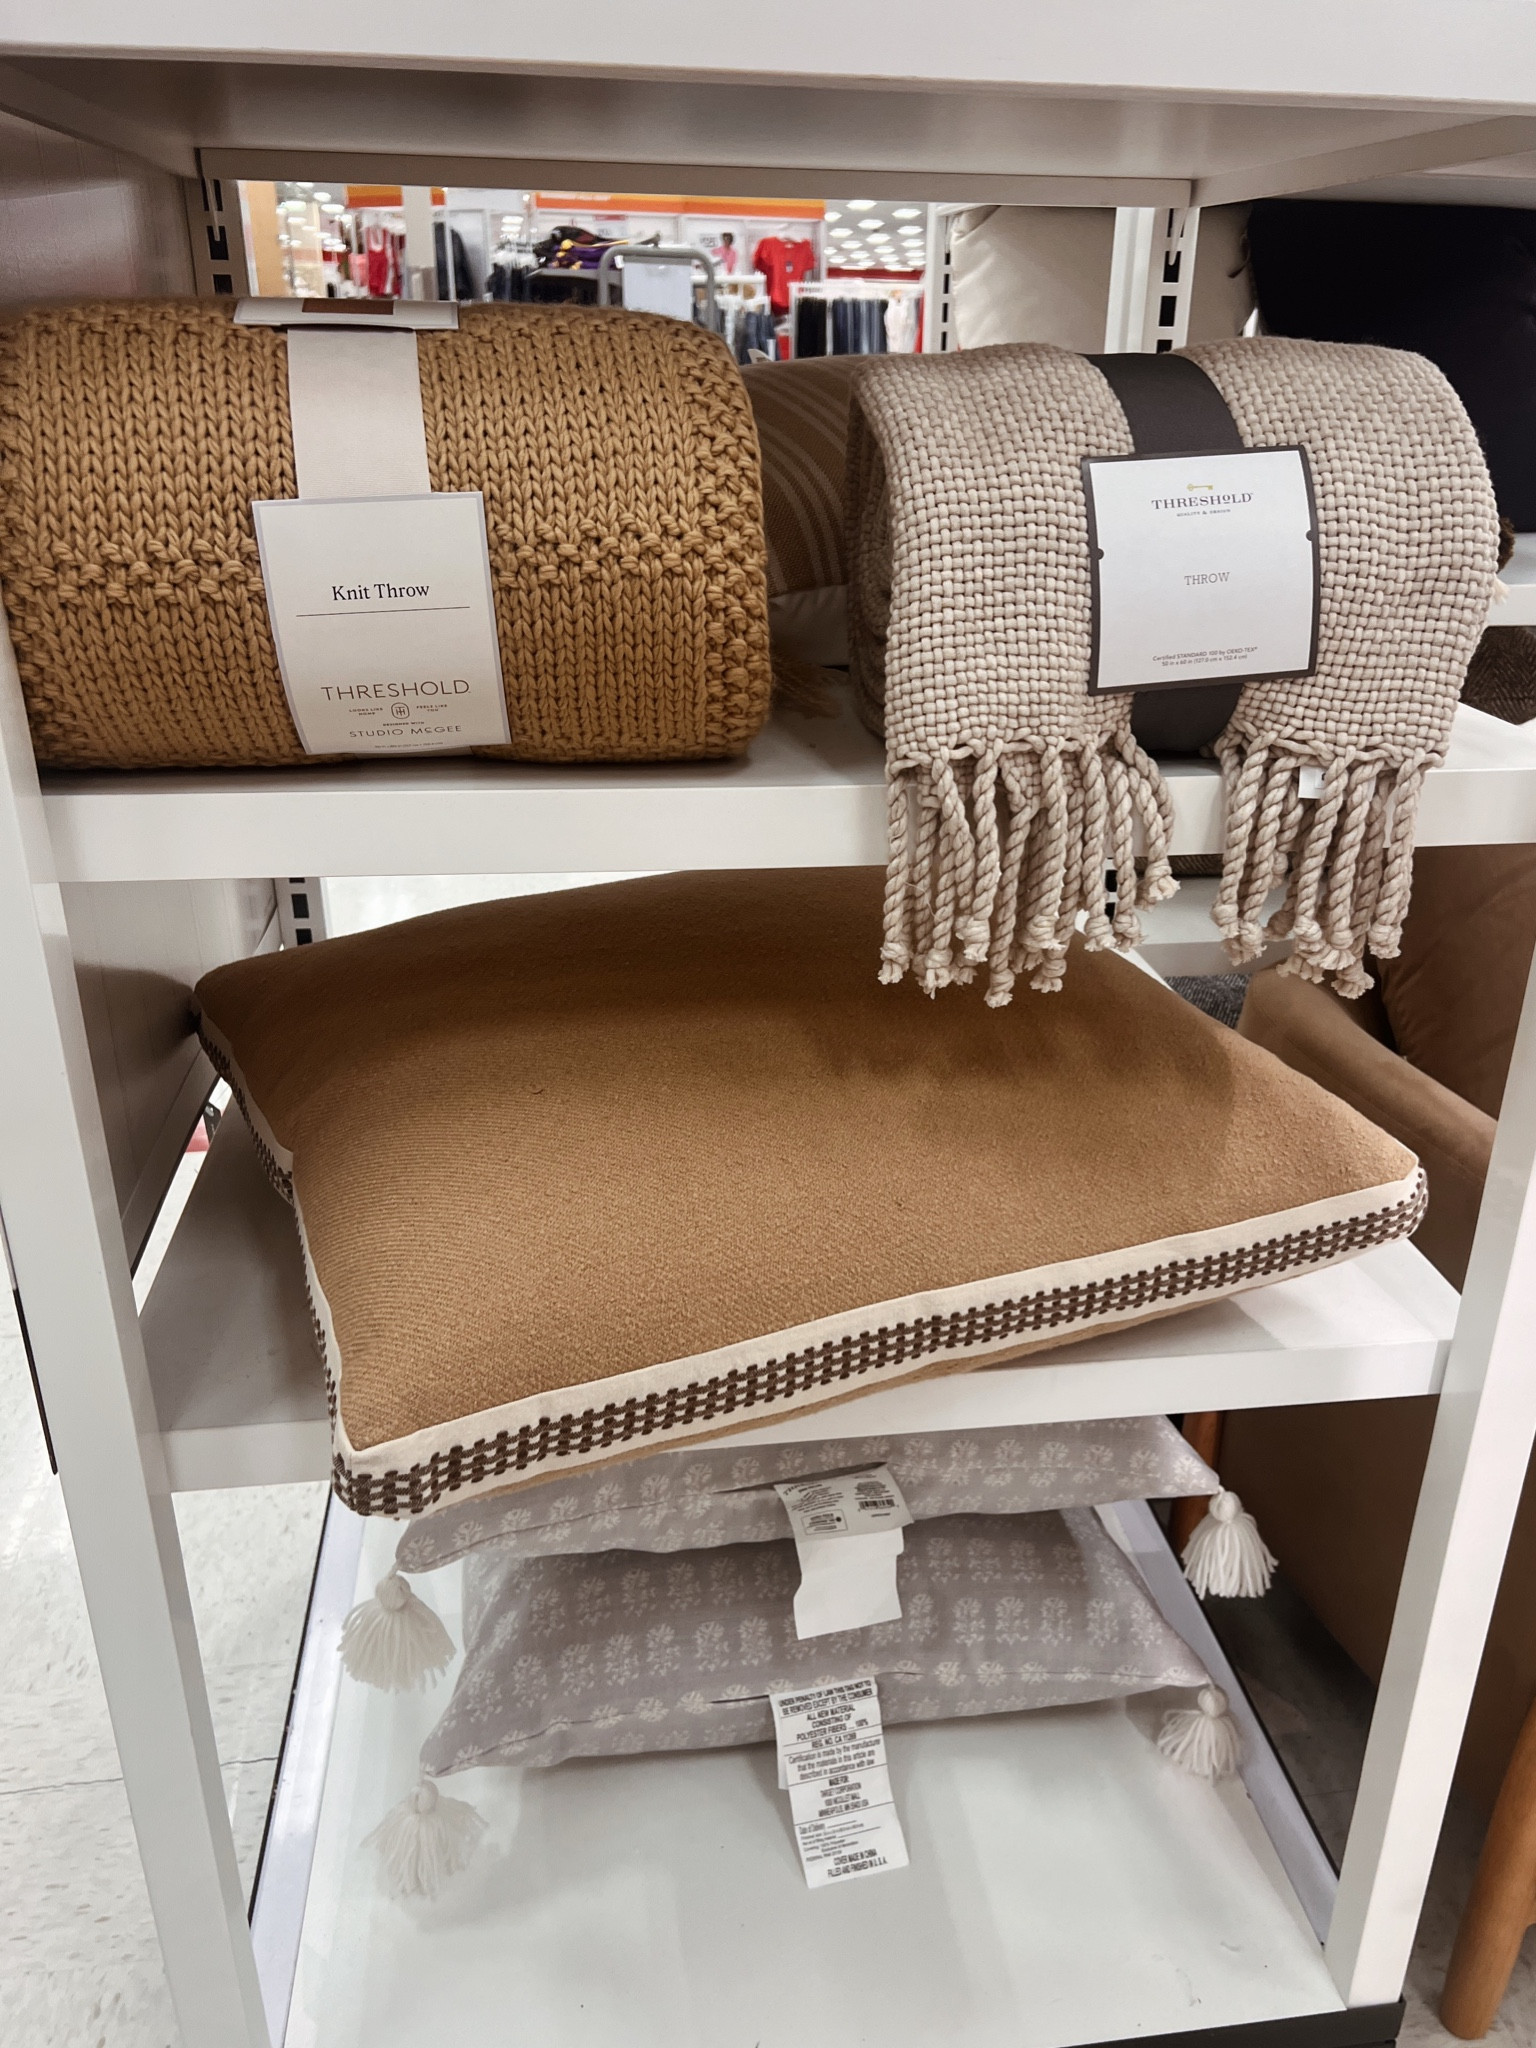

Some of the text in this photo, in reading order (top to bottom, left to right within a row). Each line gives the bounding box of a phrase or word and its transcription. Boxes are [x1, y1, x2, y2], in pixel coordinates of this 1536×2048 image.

[1151, 492, 1252, 510] THRESHOLD
[1184, 571, 1230, 586] THROW
[331, 583, 430, 601] Knit Throw
[1176, 651, 1207, 660] STANDARD
[320, 679, 471, 701] THRESHOLD
[349, 728, 404, 738] STUDIO
